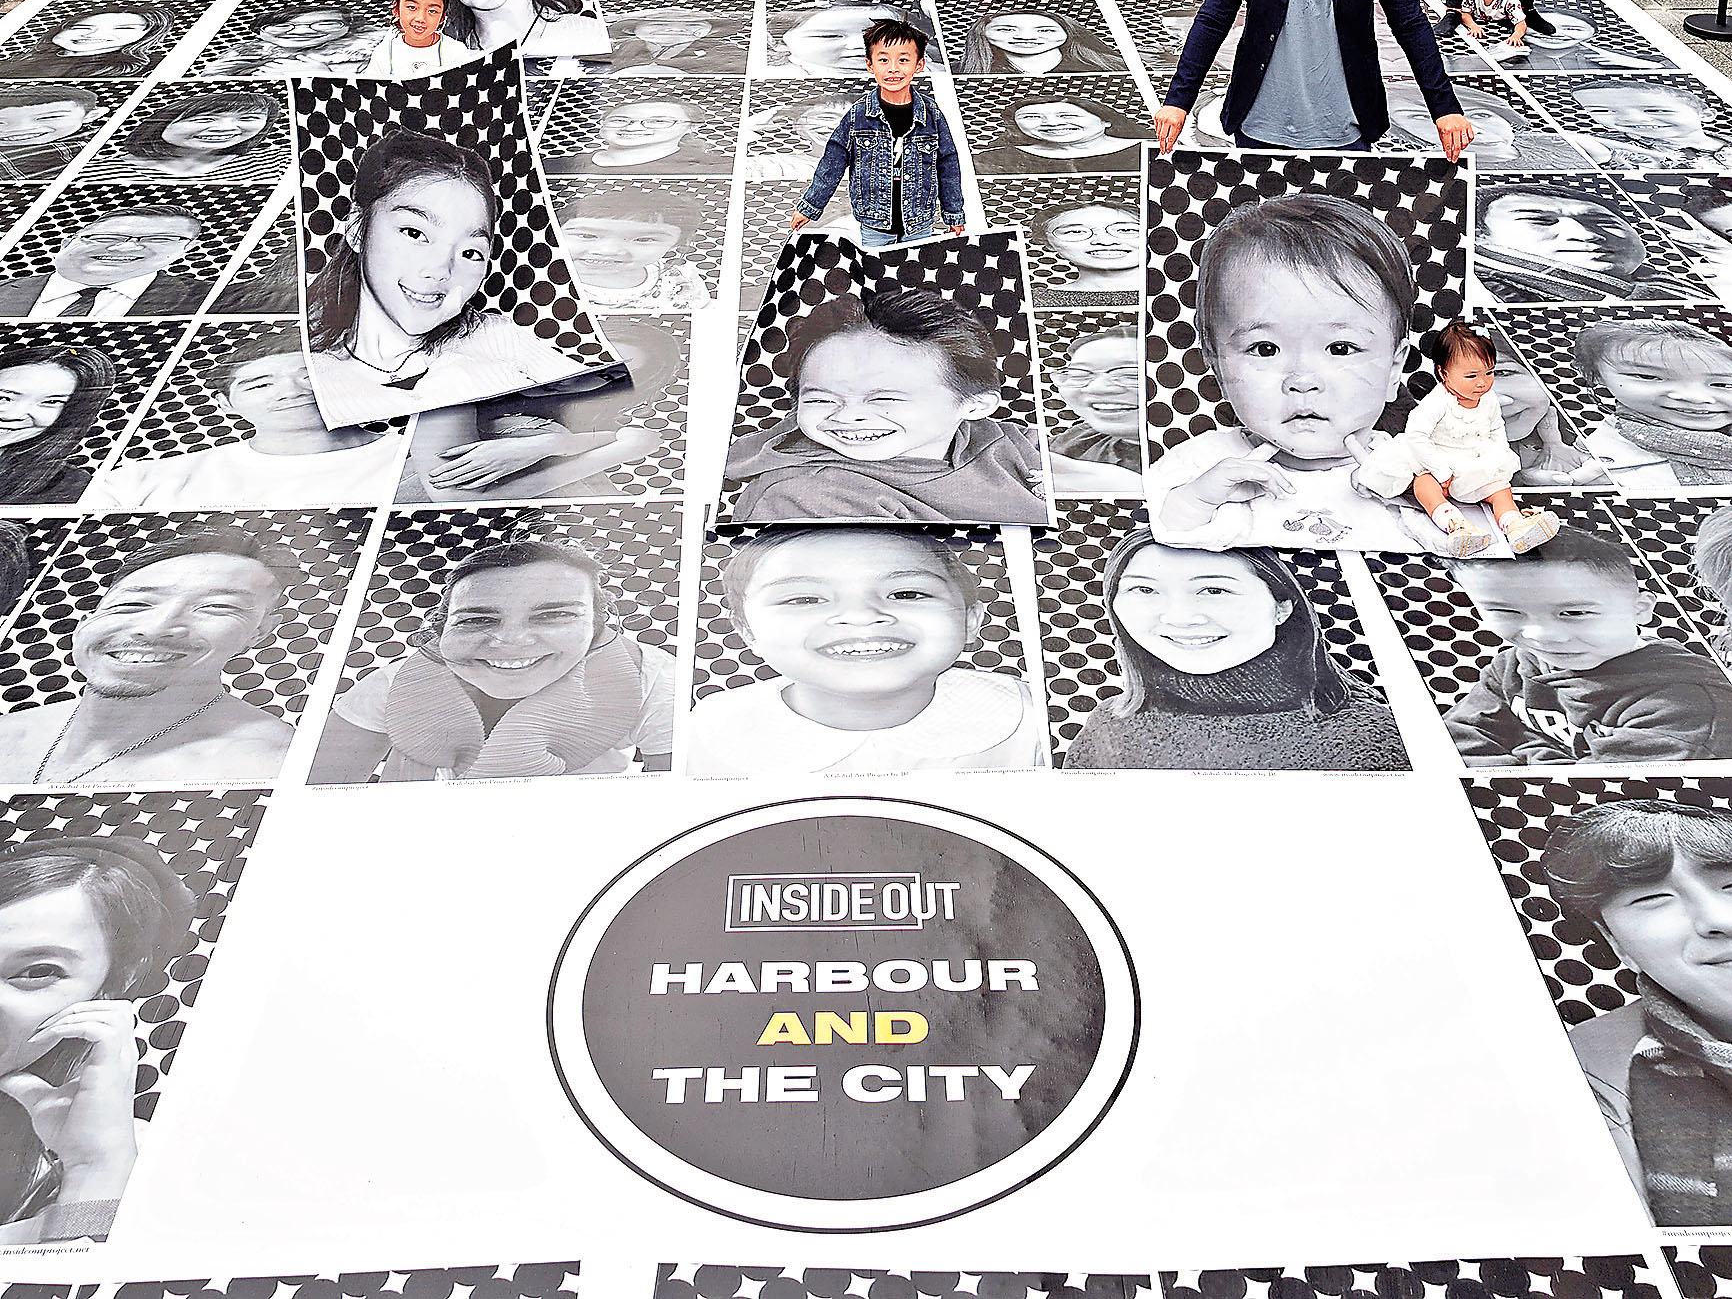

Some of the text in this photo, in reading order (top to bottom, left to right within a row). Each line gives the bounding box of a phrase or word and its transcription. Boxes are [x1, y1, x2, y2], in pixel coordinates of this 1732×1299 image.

[740, 881, 961, 922] INSIDE OUT
[648, 959, 1040, 995] HARBOUR
[756, 1011, 930, 1047] AND
[652, 1063, 1038, 1104] THE CITY
